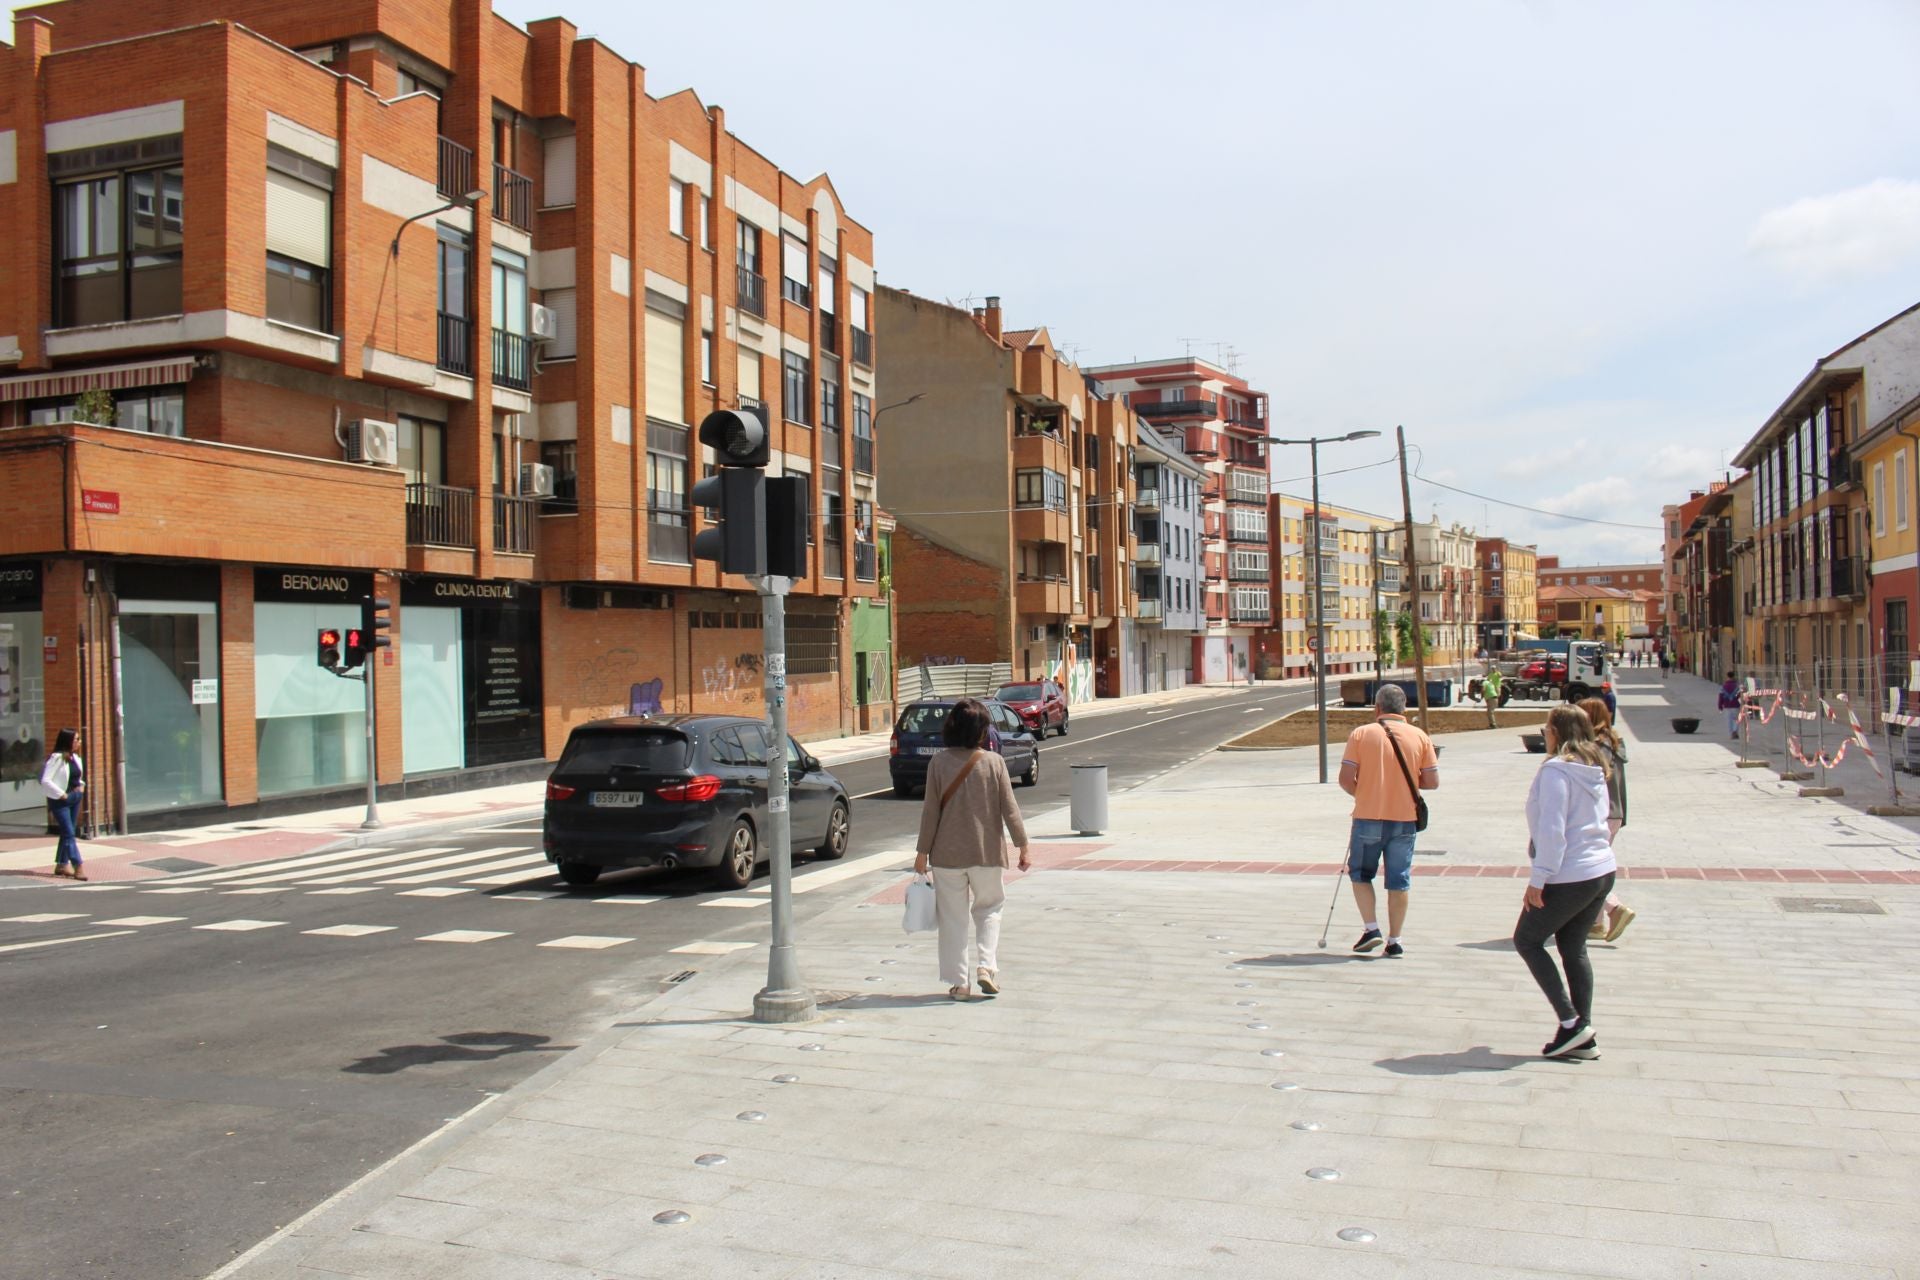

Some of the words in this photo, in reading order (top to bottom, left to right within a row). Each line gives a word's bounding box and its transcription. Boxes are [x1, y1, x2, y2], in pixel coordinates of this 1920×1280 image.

[282, 574, 349, 592] BERCIANO
[435, 582, 475, 597] CLINICA
[476, 585, 513, 599] DENTAL
[596, 793, 620, 804] 6597
